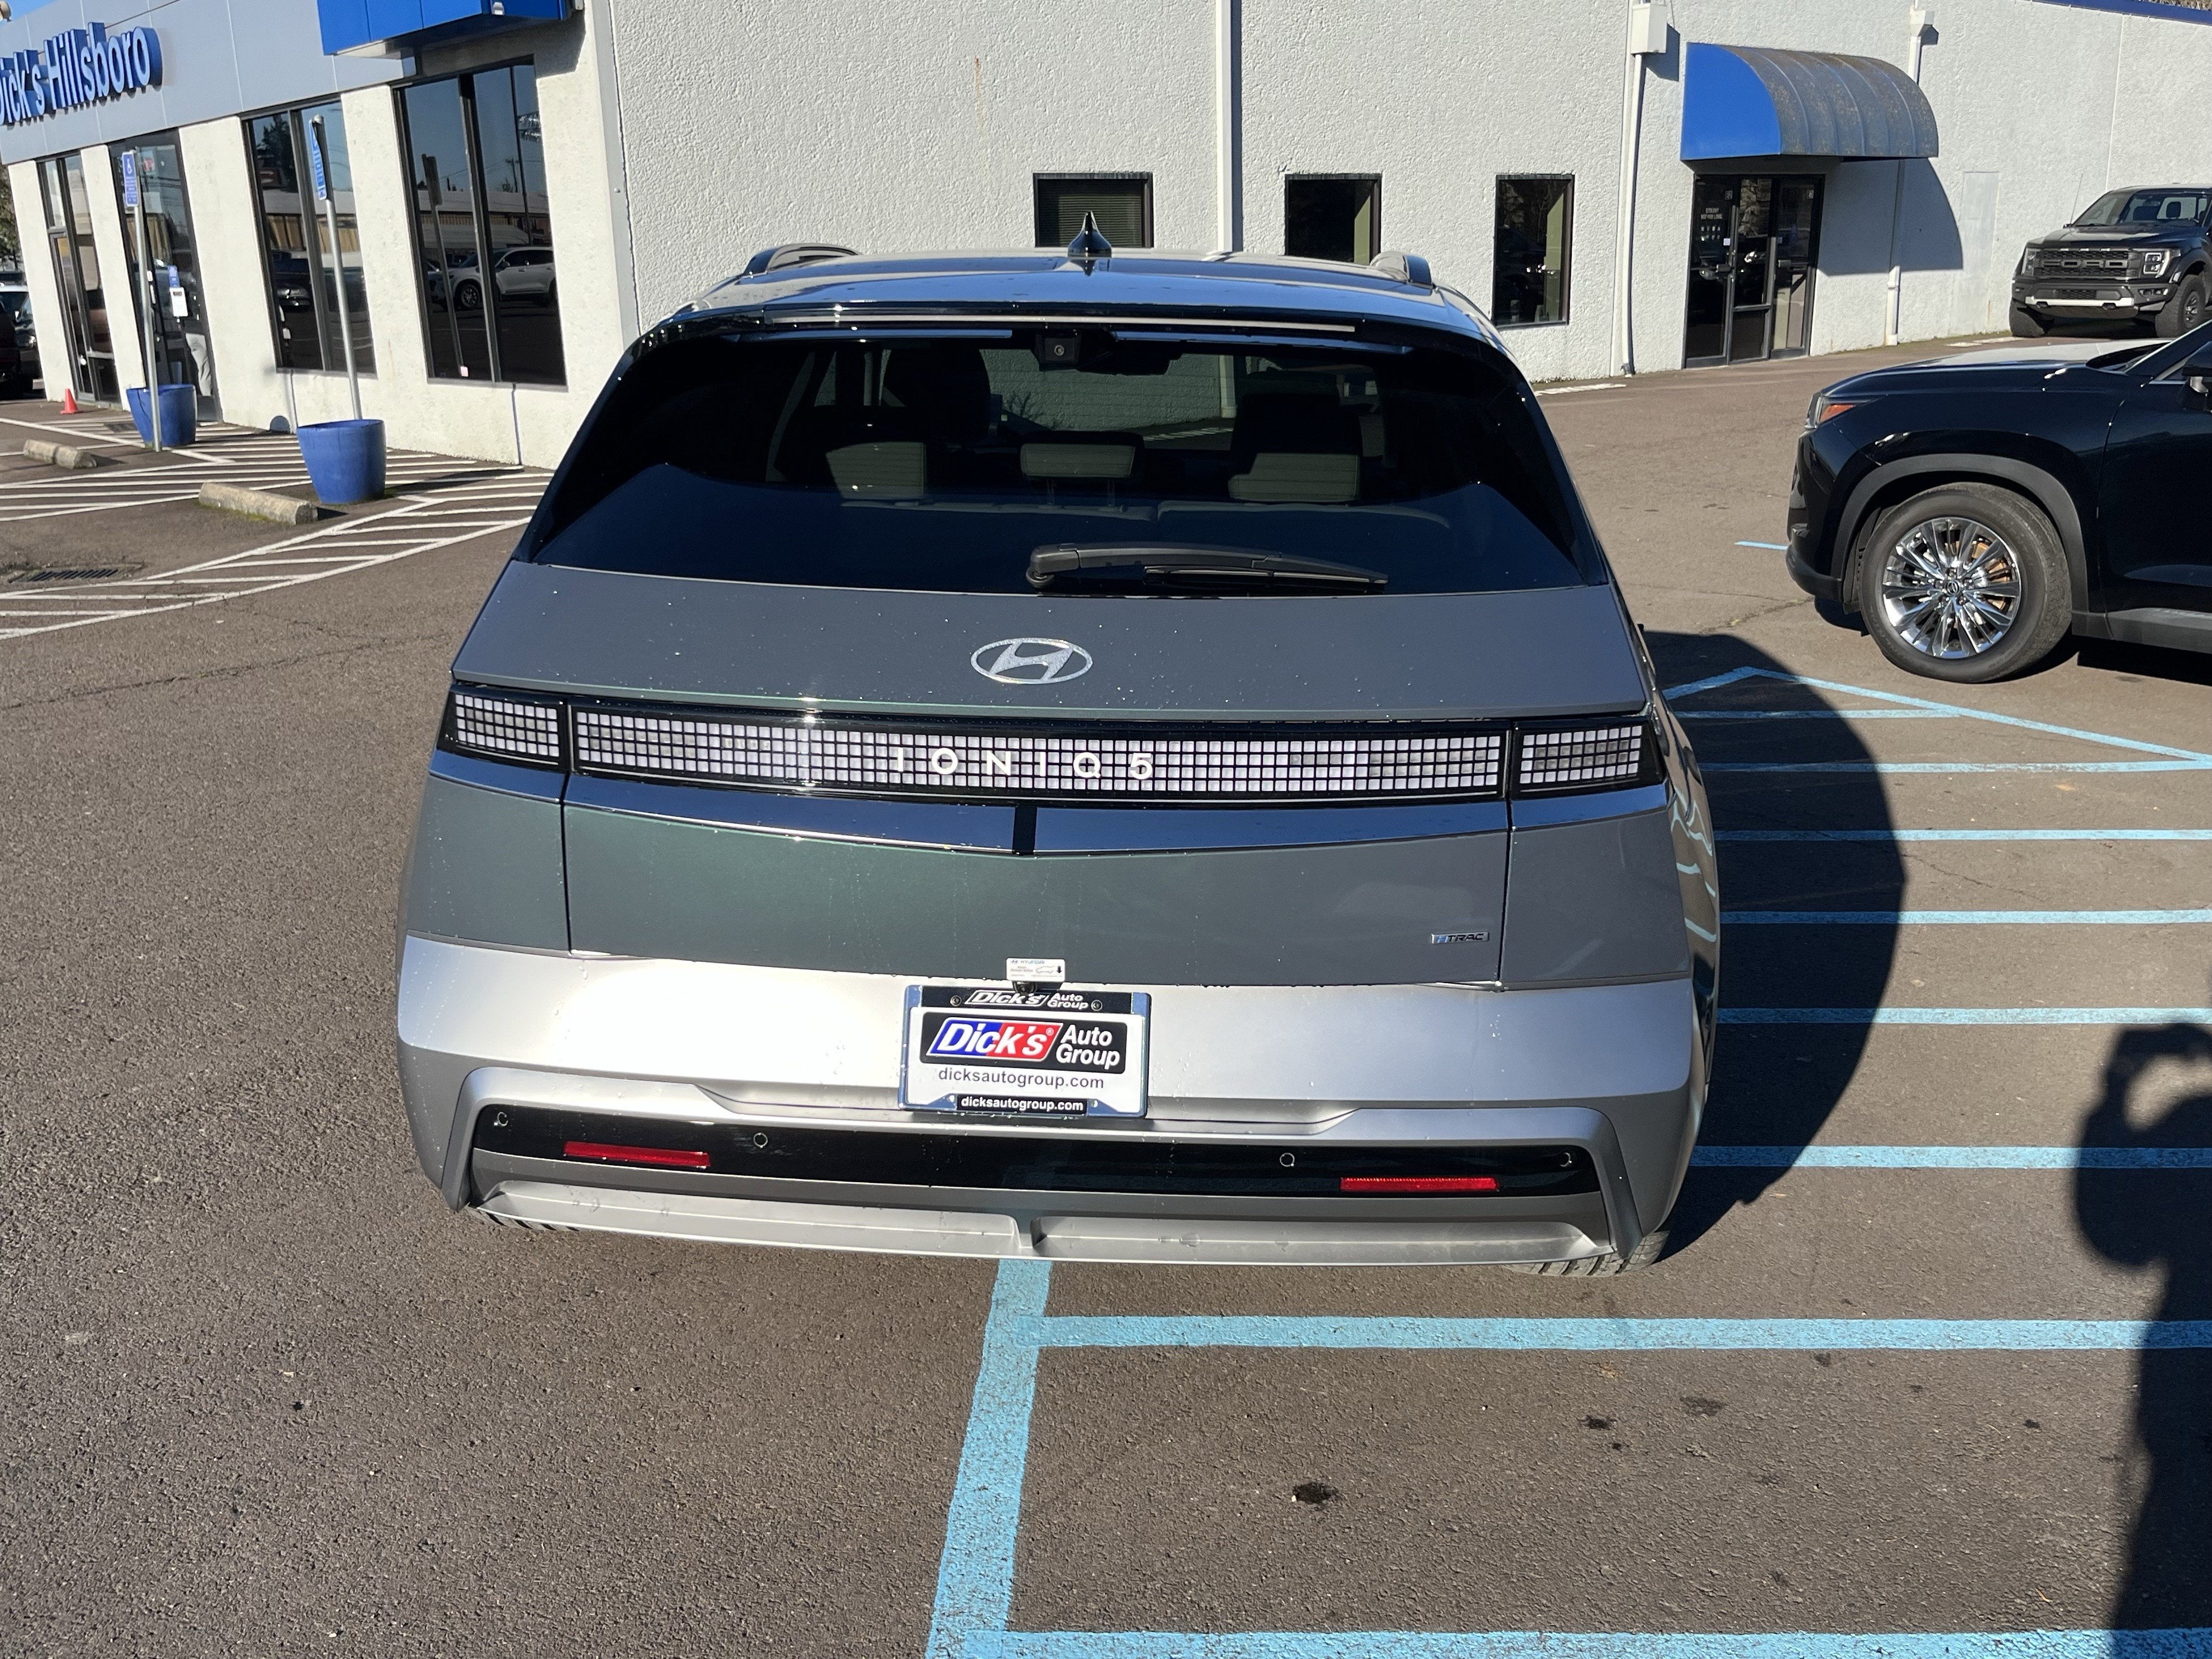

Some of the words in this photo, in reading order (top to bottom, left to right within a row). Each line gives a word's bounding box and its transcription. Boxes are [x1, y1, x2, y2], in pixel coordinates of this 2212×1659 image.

[43, 22, 151, 110] Hillsboro
[896, 747, 1101, 779] IONIQ
[1130, 752, 1153, 780] 5
[1436, 933, 1484, 943] HTRAC
[971, 992, 1042, 1005] Dick's
[1047, 1000, 1089, 1010] Group
[1050, 993, 1084, 1001] Auto
[936, 1023, 1047, 1056] Dick's
[1060, 1024, 1113, 1046] Auto
[1056, 1043, 1120, 1070] Group
[939, 1067, 1104, 1089] dicksautogroup.com
[961, 1096, 1084, 1113] dicksautogroup.com
